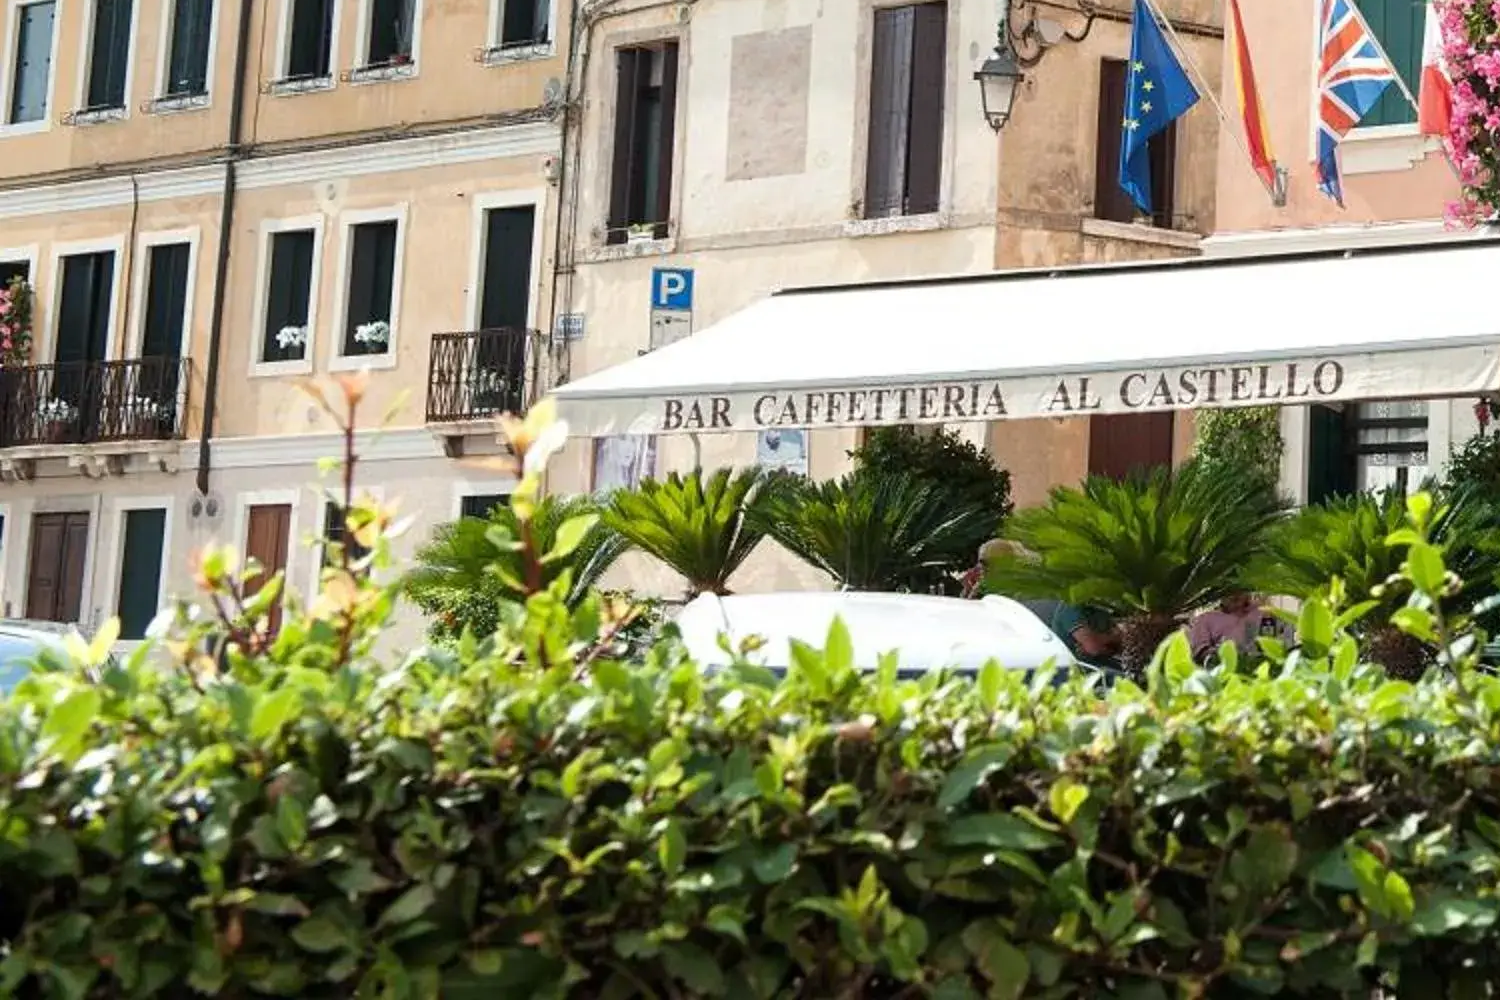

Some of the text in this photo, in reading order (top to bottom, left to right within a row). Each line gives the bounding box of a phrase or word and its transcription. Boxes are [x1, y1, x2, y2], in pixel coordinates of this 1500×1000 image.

[659, 271, 686, 305] P
[663, 360, 1344, 430] BAR CAFFETTERIA AL CASTELLO
